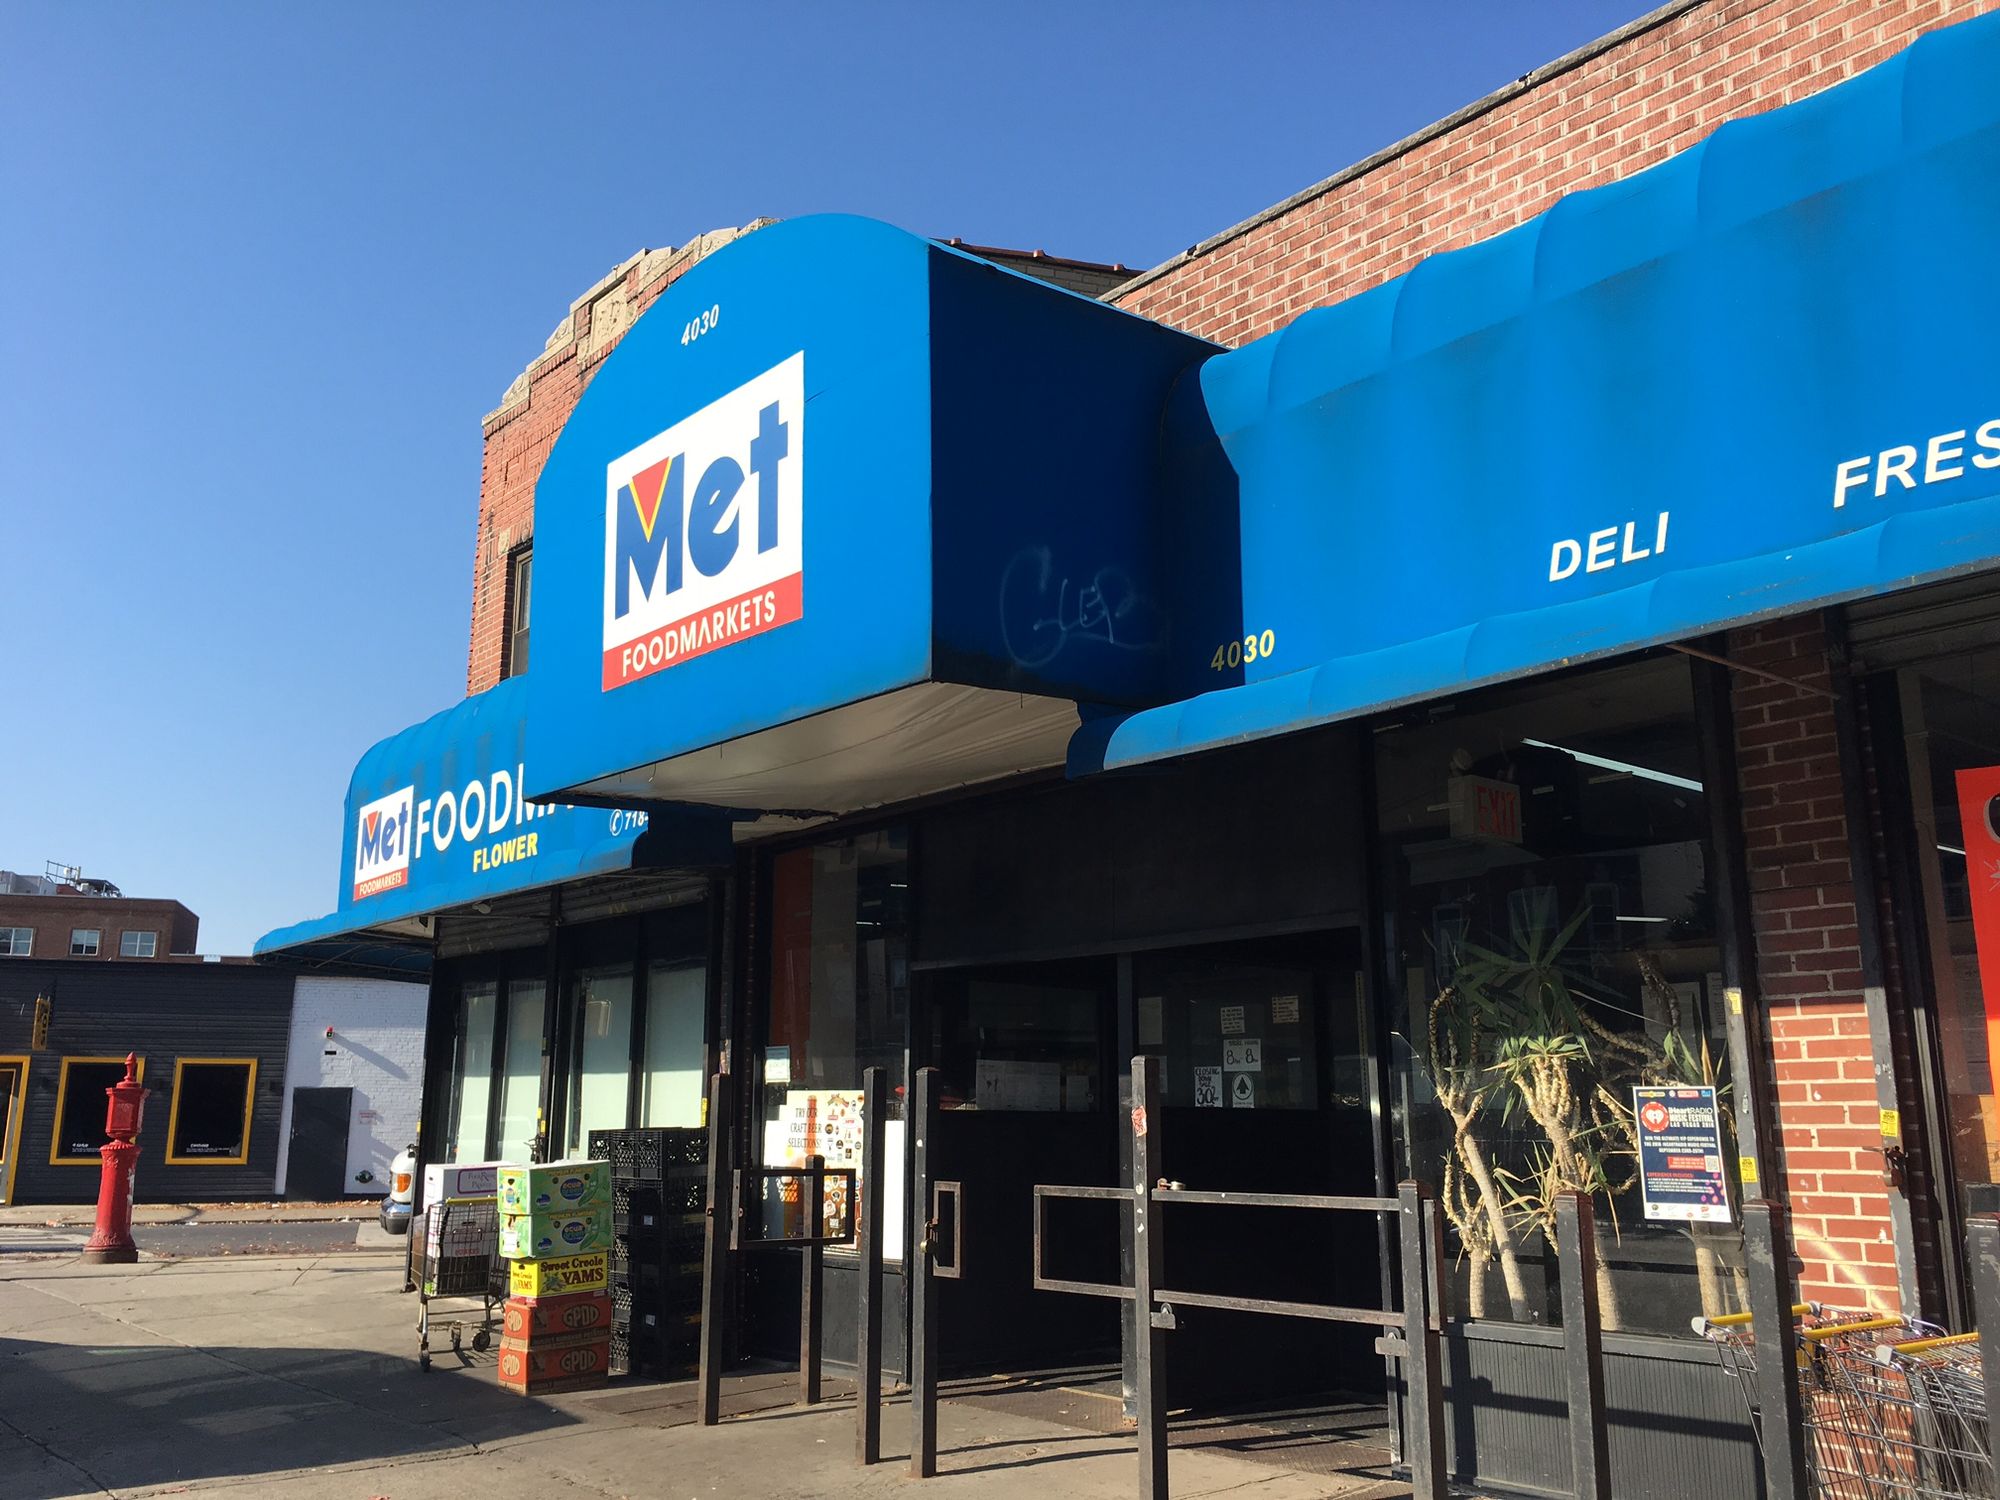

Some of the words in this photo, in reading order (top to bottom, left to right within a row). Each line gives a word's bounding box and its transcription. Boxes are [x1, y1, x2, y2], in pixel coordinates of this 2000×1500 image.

[681, 304, 719, 345] 4030
[1833, 419, 2000, 509] FRES
[614, 400, 788, 620] Met
[1549, 511, 1669, 582] DELI
[622, 591, 776, 677] FOODMARKETS
[1211, 629, 1275, 671] 4030
[415, 763, 575, 859] FOOD
[1477, 785, 1517, 837] EXIT
[359, 801, 408, 870] Met
[473, 832, 538, 872] FLOWER
[359, 871, 402, 895] FOODMARKETS
[790, 1123, 807, 1133] CRAFT
[795, 1108, 805, 1118] TRY
[541, 1261, 570, 1272] Sweet
[572, 1256, 603, 1269] Creole
[561, 1268, 604, 1285] YAMS
[563, 1304, 599, 1328] GPOD
[561, 1350, 597, 1373] GPOD
